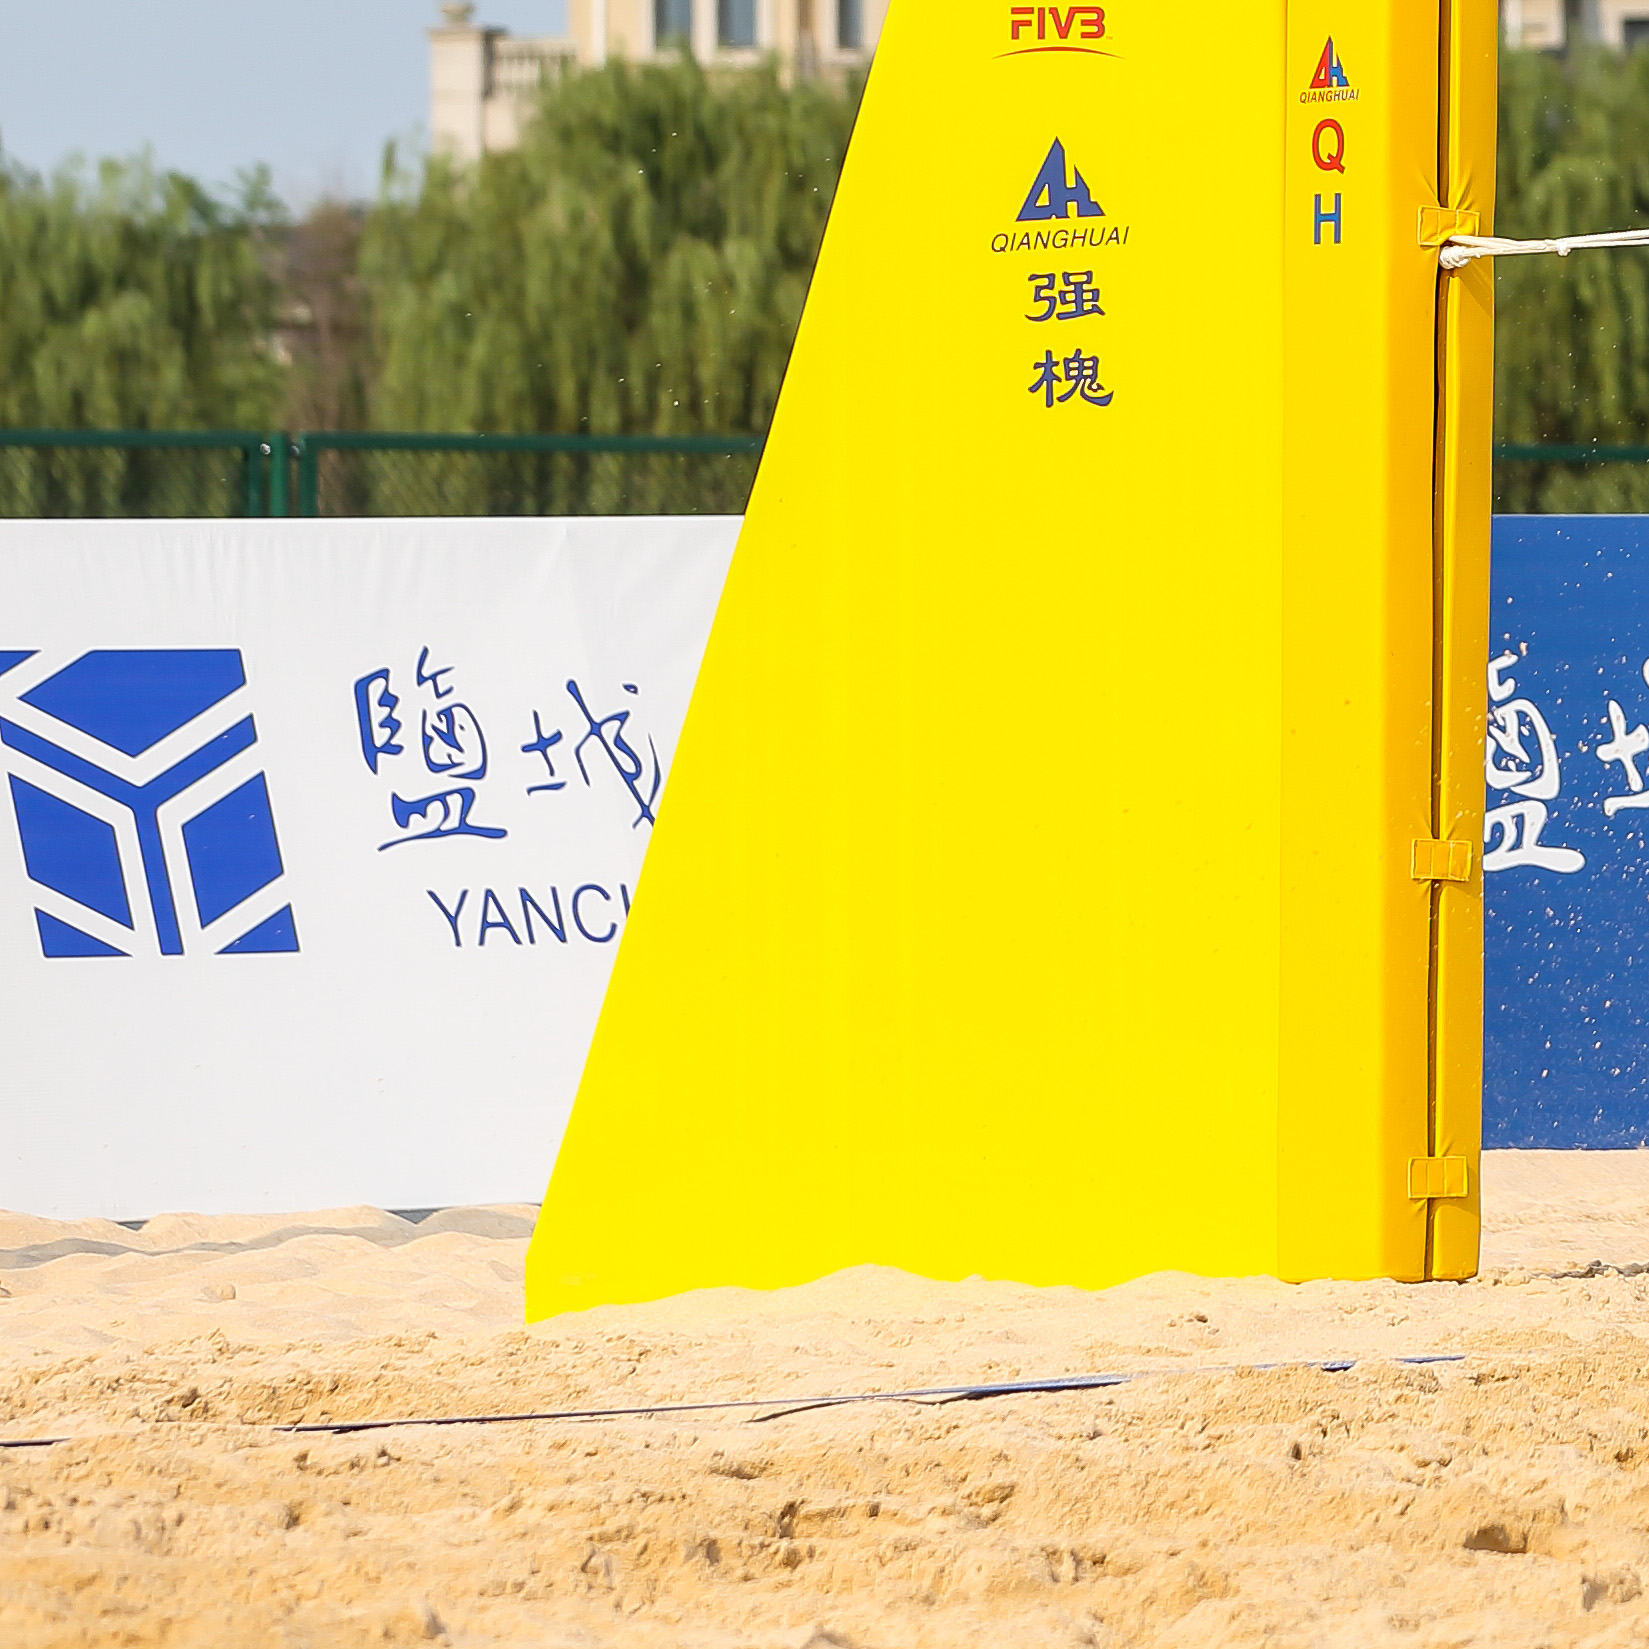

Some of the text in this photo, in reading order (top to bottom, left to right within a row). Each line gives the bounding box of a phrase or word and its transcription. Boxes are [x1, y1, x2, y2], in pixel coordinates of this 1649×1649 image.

[1010, 5, 1107, 40] FIVB
[1299, 88, 1360, 105] QIANGHUAI
[991, 226, 1129, 253] QIANGHUAI
[1025, 269, 1114, 408] 强槐
